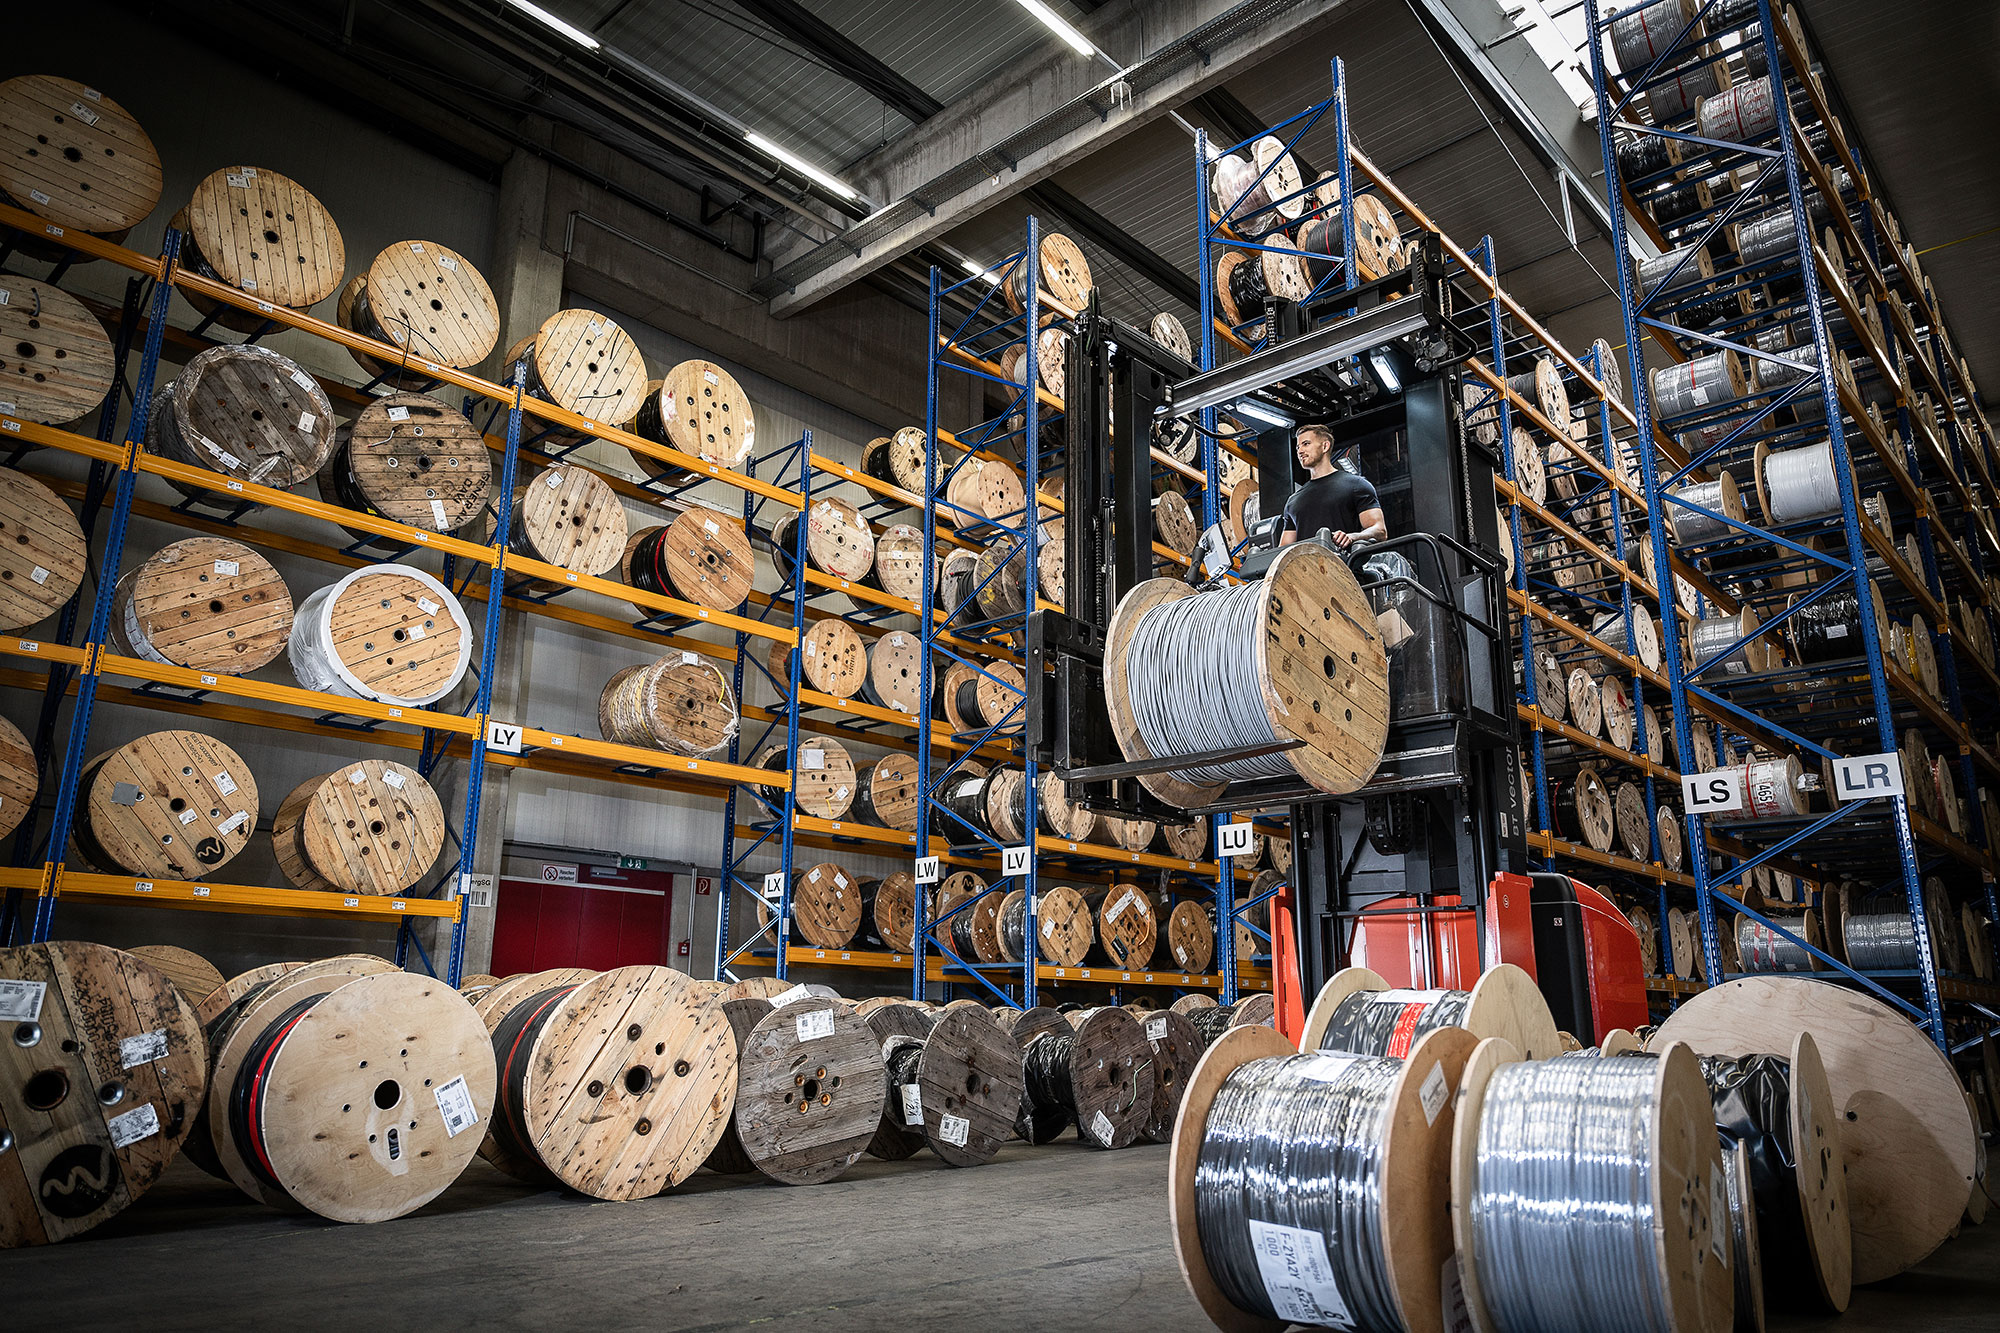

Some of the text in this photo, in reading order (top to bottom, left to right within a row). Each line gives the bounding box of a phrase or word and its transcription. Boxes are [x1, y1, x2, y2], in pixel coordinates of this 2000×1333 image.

[1267, 595, 1283, 643] 110
[493, 728, 516, 746] LY
[1842, 762, 1892, 791] LR
[1505, 746, 1520, 836] BT vector
[1690, 779, 1731, 806] LS
[1758, 784, 1773, 802] 465
[1223, 829, 1247, 849] LU
[917, 862, 936, 878] LW
[1007, 852, 1026, 869] LV
[767, 878, 781, 892] LX
[1280, 1232, 1301, 1280] F-2YA2Y
[1324, 1310, 1345, 1320] 8
